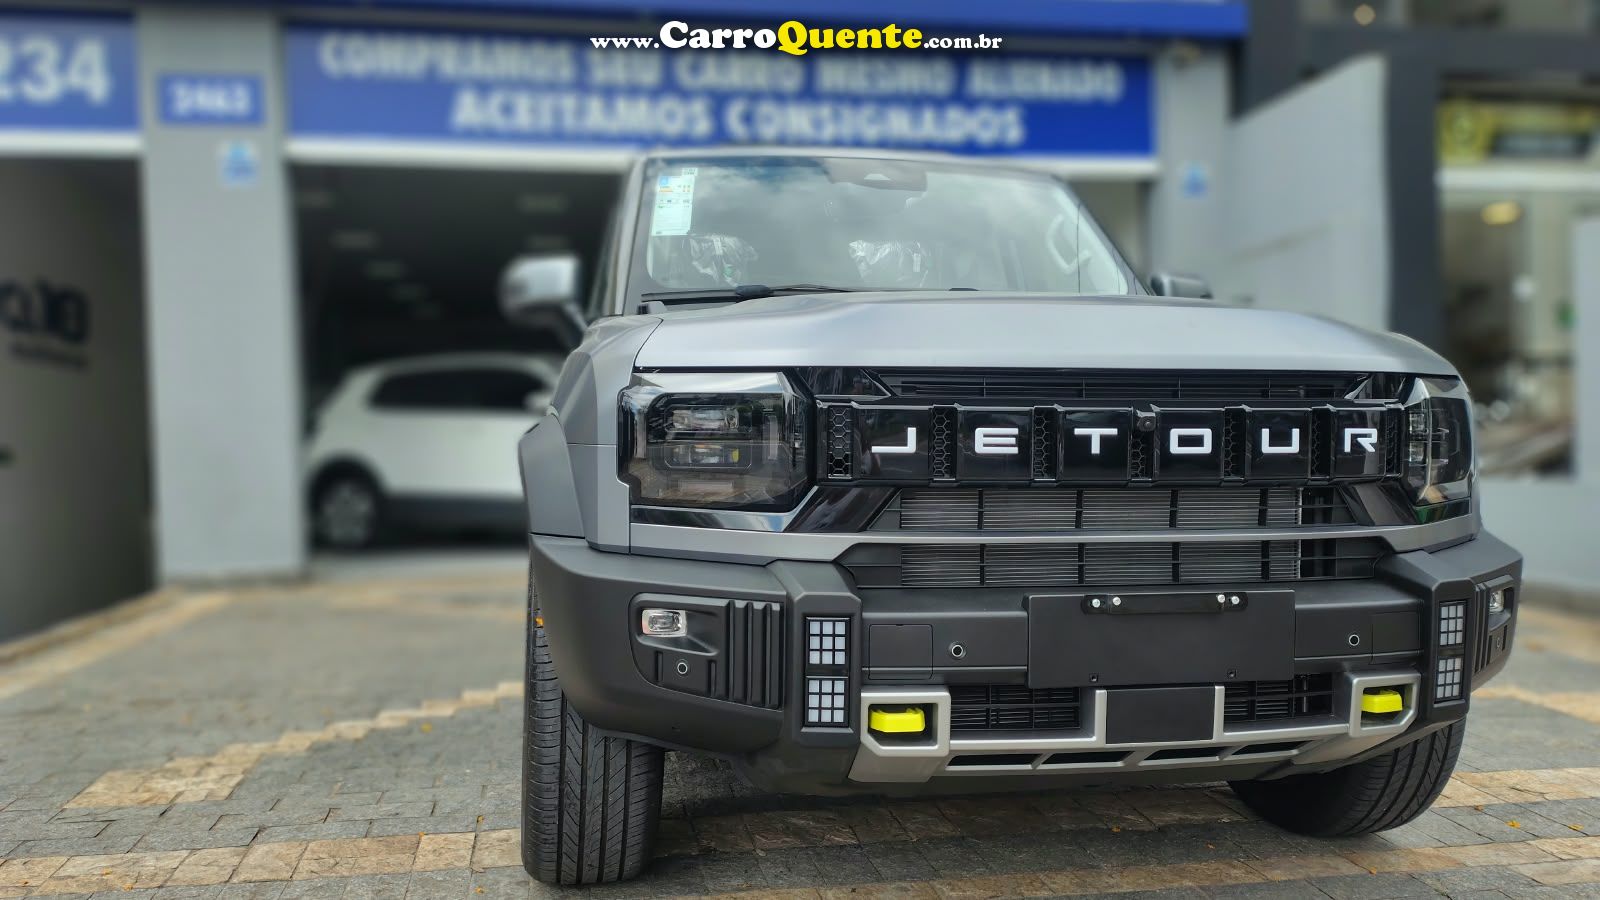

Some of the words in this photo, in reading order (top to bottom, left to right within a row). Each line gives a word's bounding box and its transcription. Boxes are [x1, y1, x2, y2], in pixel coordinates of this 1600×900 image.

[320, 33, 575, 81] COMPRAMOS
[589, 47, 661, 87] SEU
[676, 50, 805, 92] CARRO
[452, 88, 713, 139] ACEITAMOS
[726, 98, 1024, 146] CONSIGNADOS
[871, 427, 1378, 454] JETOUR
